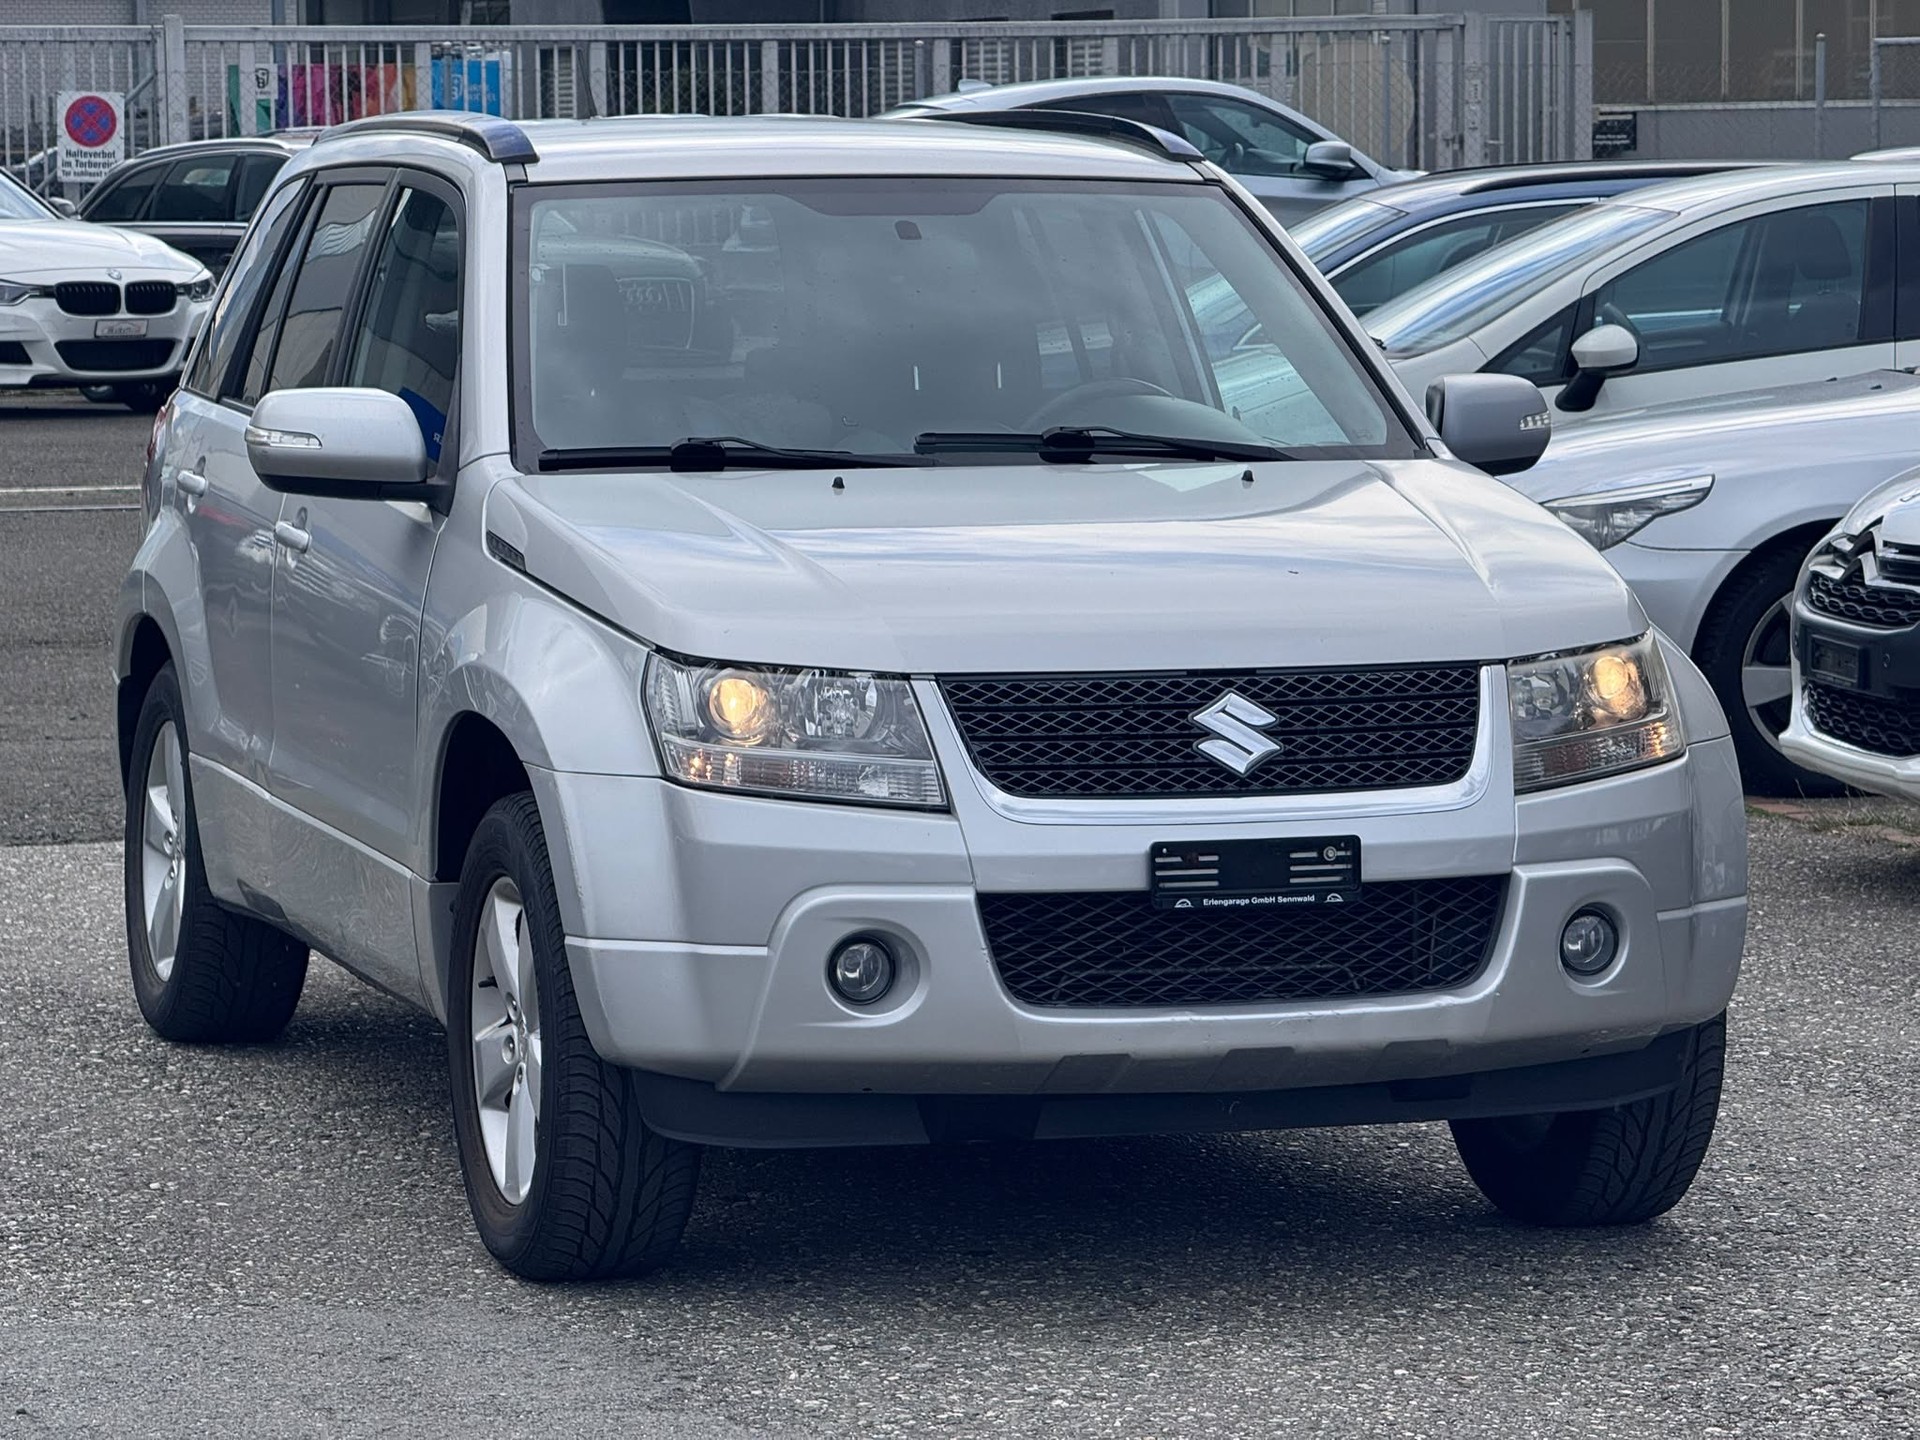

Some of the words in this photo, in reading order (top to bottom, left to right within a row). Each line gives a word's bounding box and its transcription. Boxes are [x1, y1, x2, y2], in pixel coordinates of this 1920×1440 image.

[65, 149, 115, 159] Halteverbot
[61, 159, 72, 168] im
[1203, 898, 1250, 907] Erlengarage
[1251, 896, 1276, 904] GmbH
[1277, 894, 1315, 903] Sennwald
